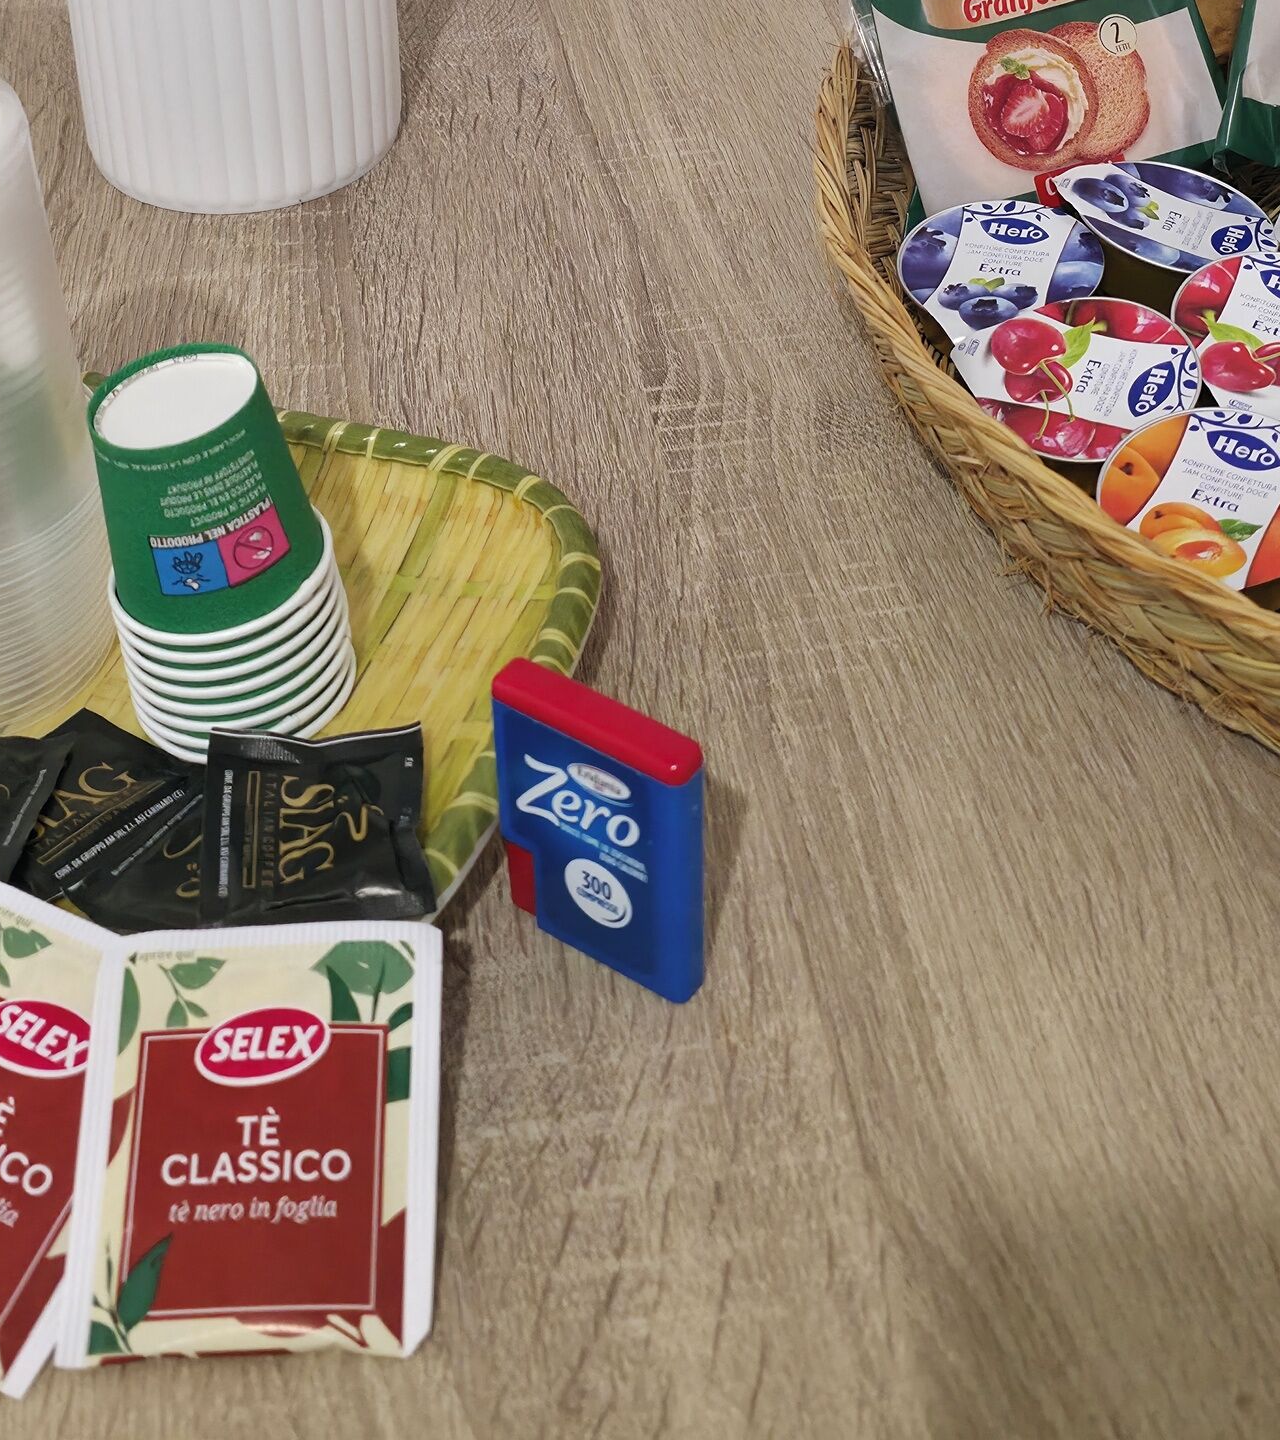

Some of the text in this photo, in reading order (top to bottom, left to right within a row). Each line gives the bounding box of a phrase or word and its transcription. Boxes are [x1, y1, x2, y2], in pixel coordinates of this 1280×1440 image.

[1110, 21, 1124, 44] 2
[987, 221, 1043, 239] Hero
[1161, 209, 1182, 233] Extra
[1218, 224, 1246, 257] Hero
[978, 263, 1021, 276] Extra
[1238, 292, 1280, 310] KONFITURE
[1240, 301, 1257, 310] JAM
[1074, 357, 1101, 396] Extra
[1133, 362, 1170, 416] Hero
[1212, 433, 1278, 467] Hero
[1181, 456, 1278, 493] KONFITURE CONFETTURA
[1181, 466, 1269, 499] JAM CONFITURA DOCE
[1198, 481, 1243, 500] CONFITURE
[1190, 487, 1240, 512] Extra
[150, 497, 271, 548] PLASTICA NEL PRODOTTO
[516, 753, 640, 847] Zero
[582, 870, 612, 900] 300
[209, 1023, 315, 1062] SELEX
[236, 1108, 279, 1146] TÈ
[161, 1149, 351, 1186] CLASSICO
[169, 1195, 337, 1224] tè nero in foglia
